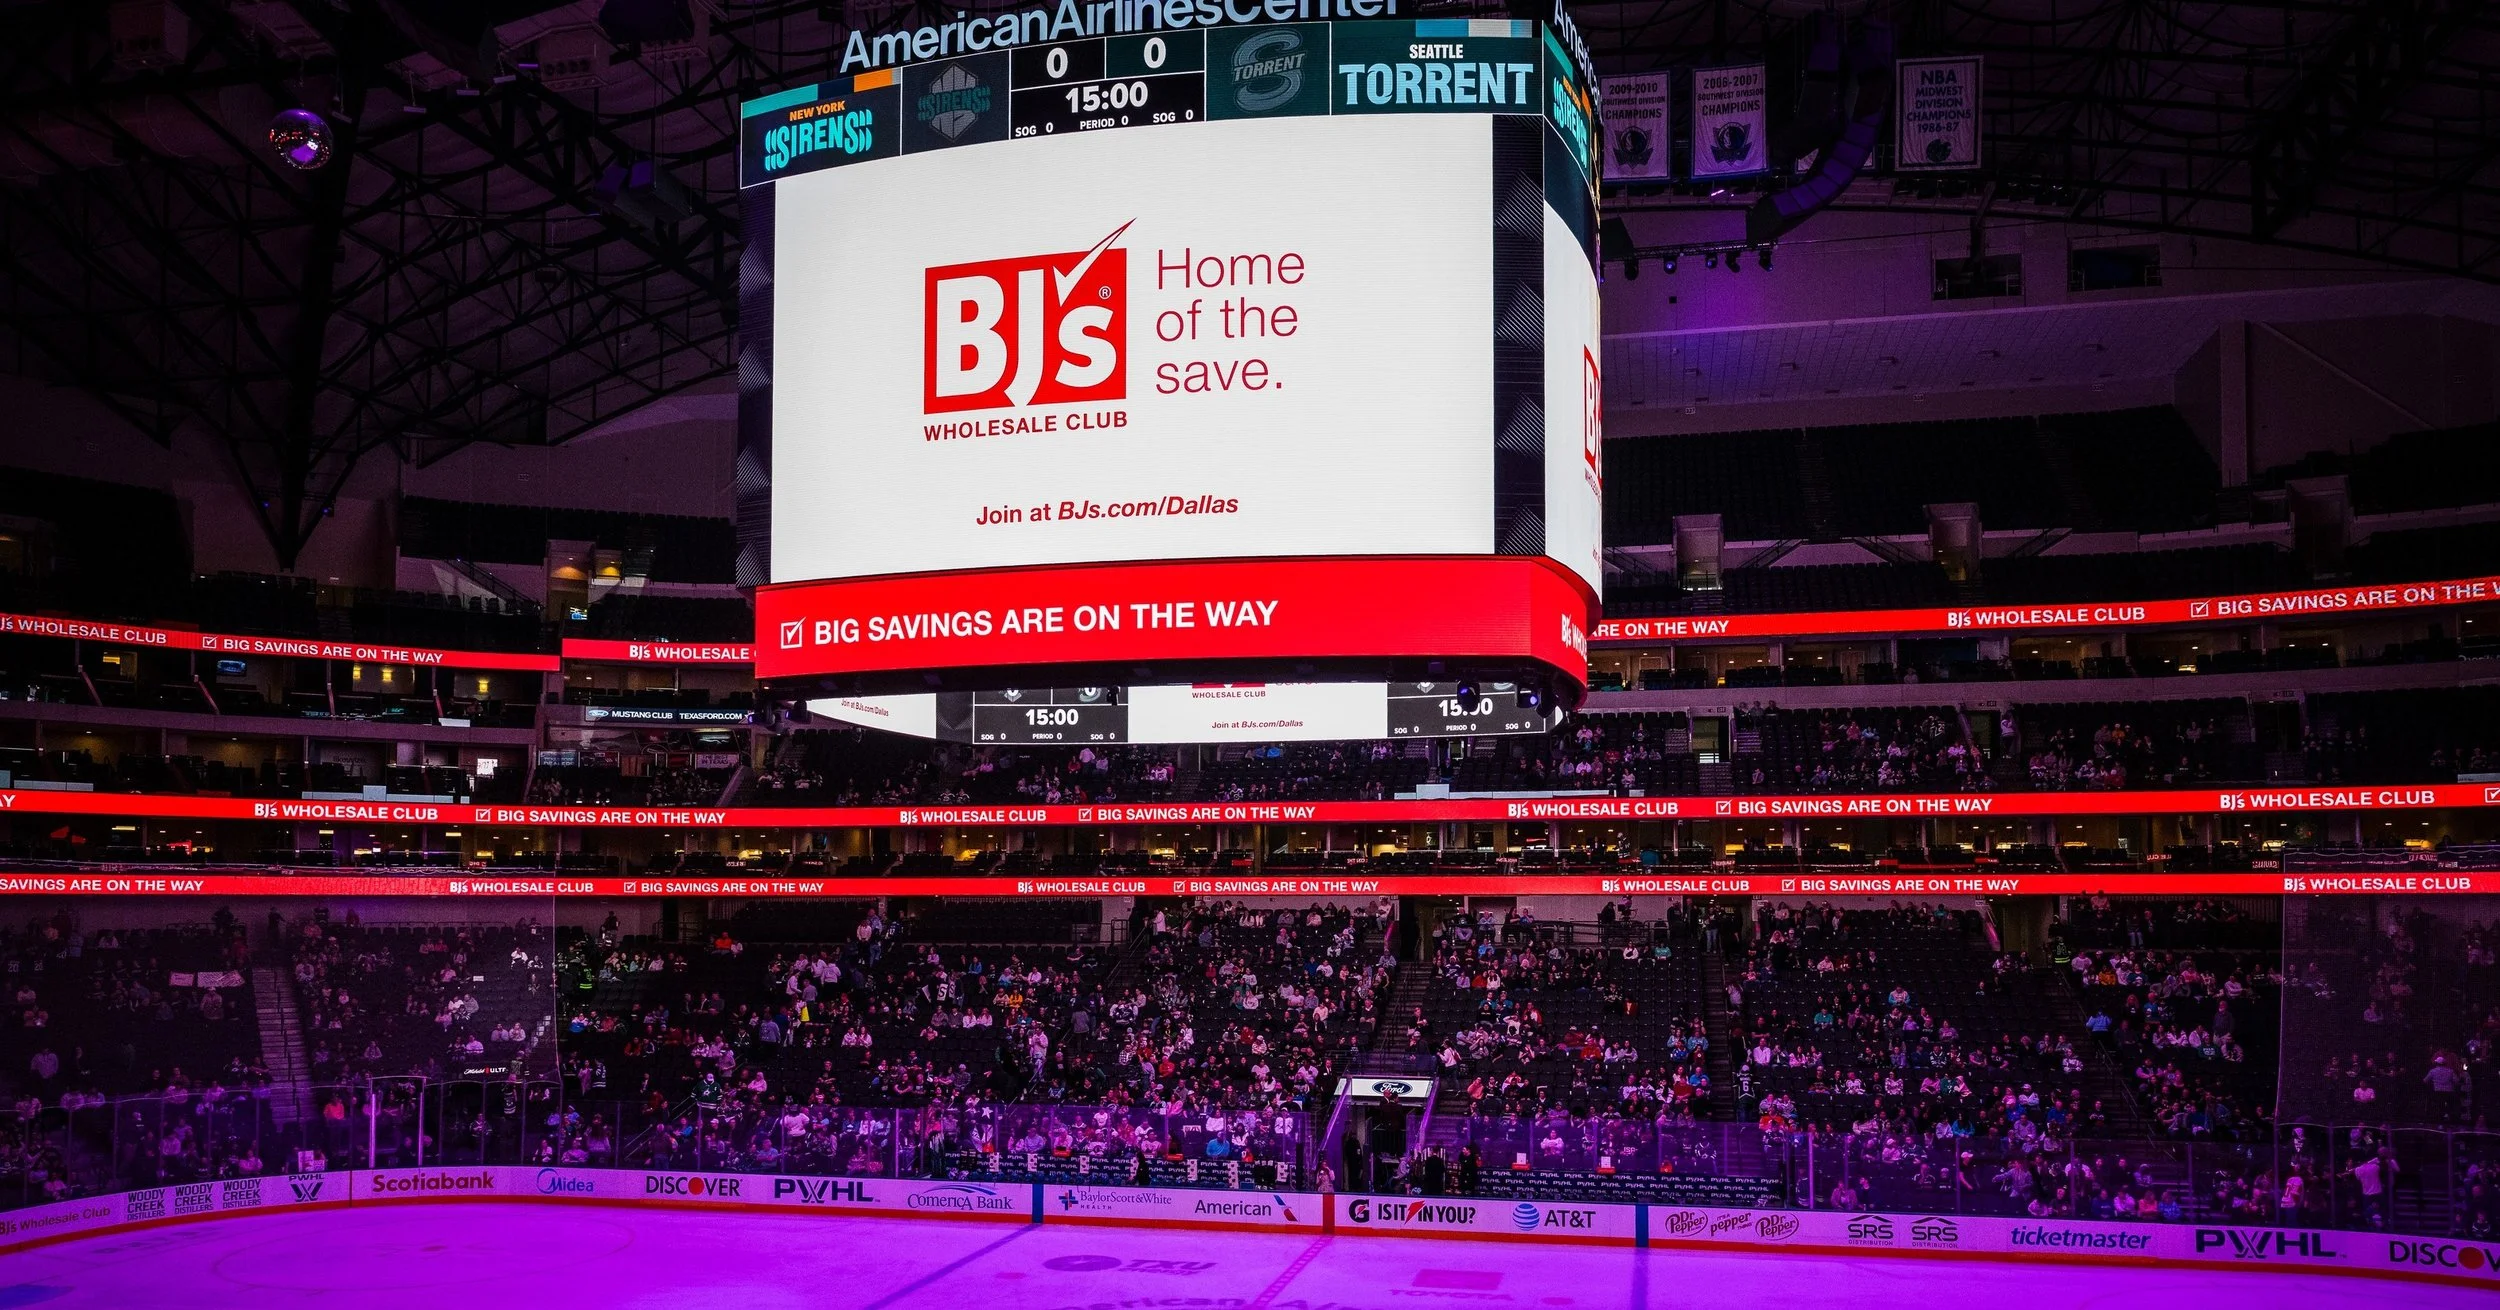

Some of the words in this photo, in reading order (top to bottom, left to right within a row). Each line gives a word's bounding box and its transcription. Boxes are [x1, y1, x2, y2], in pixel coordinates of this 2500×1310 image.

[1144, 37, 1166, 68] 0
[1409, 44, 1463, 59] SEATTLE
[1046, 47, 1068, 78] 0
[1233, 52, 1305, 82] TORRENT
[1339, 62, 1533, 105] TORRENT
[1702, 74, 1758, 89] 2006-2007
[1920, 69, 1957, 85] NBA
[1065, 81, 1149, 114] 15:00
[1608, 82, 1658, 96] 2009-2010
[1915, 84, 1963, 98] MIDWEST
[789, 106, 813, 122] NEW
[816, 100, 846, 117] YORK
[1702, 100, 1761, 116] CHAMPIONS
[1914, 97, 1963, 110] DIVISION
[1080, 117, 1115, 131] PERIOD
[1121, 114, 1129, 127] 0
[1152, 111, 1176, 124] SOG
[1185, 109, 1193, 121] 0
[1605, 107, 1662, 121] CHAMPIONS
[1906, 109, 1971, 122] CHAMPIONS
[1015, 125, 1037, 138] SOG
[1045, 121, 1054, 134] 0
[1917, 121, 1959, 134] 1986-87
[765, 108, 872, 171] SIRENS
[1158, 247, 1305, 290] Home
[1156, 299, 1202, 342] of
[1219, 296, 1298, 339] the
[1156, 356, 1282, 395] save.
[923, 414, 1057, 442] WHOLESALE
[1066, 410, 1128, 431] CLUB
[976, 505, 1022, 526] Join
[1029, 503, 1052, 523] at
[1057, 495, 1239, 521] BJs.com/Dallas
[2218, 599, 2252, 615] BIG
[2258, 593, 2348, 611] SAVINGS
[2353, 589, 2397, 606] ARE
[2403, 587, 2435, 603] ON
[2441, 582, 2487, 600] THE
[814, 618, 860, 645] BIG
[867, 610, 993, 642] SAVINGS
[1000, 606, 1064, 635] ARE
[1073, 604, 1120, 632] ON
[1129, 602, 1195, 629] THE
[1204, 600, 1279, 627] WAY
[1947, 610, 1972, 629] BJ's
[1975, 608, 2089, 625] WHOLESALE
[2094, 606, 2145, 622] CLUB
[17, 619, 120, 640] WHOLESALE
[124, 629, 167, 644] CLUB
[1625, 622, 1649, 637] ON
[1654, 621, 1688, 635] THE
[1692, 619, 1729, 634] WAY
[223, 638, 250, 651] BIG
[254, 640, 319, 656] SAVINGS
[322, 645, 352, 658] ARE
[355, 647, 382, 660] ON
[381, 649, 409, 661] THE
[412, 651, 443, 664] WAY
[629, 644, 651, 660] BJ's
[654, 646, 750, 660] WHOLESALE
[1192, 689, 1241, 699] WHOLESALE
[1244, 689, 1266, 698] CLUB
[611, 710, 651, 720] MUSTANG
[651, 711, 673, 720] CLUB
[679, 711, 742, 721] TEXASFORD.COM
[1026, 708, 1079, 726] 15:00
[1211, 719, 1229, 729] Join
[1231, 720, 1240, 729] at
[1241, 718, 1304, 729] BJs.com/Dallas
[1394, 727, 1408, 735] SOG
[1413, 725, 1420, 734] 0
[1446, 724, 1467, 732] PERIOD
[1470, 723, 1477, 732] 0
[1525, 721, 1531, 729] 0
[981, 733, 994, 741] SOG
[1000, 732, 1006, 741] 0
[1032, 733, 1054, 741] PERIOD
[1057, 732, 1062, 741] 0
[1090, 733, 1104, 741] SOG
[1110, 732, 1115, 740] 0
[2220, 792, 2246, 811] BJ's
[2249, 791, 2373, 808] WHOLESALE
[2378, 790, 2435, 806] CLUB
[254, 801, 278, 819] BJ's
[282, 804, 389, 819] WHOLESALE
[392, 807, 439, 821] CLUB
[497, 809, 525, 822] BIG
[529, 810, 597, 824] SAVINGS
[599, 810, 632, 824] ARE
[635, 811, 658, 824] ON
[661, 812, 690, 824] THE
[693, 812, 726, 824] WAY
[0, 878, 66, 891] SAVINGS
[69, 879, 102, 891] ARE
[106, 879, 131, 891] ON
[134, 879, 166, 891] THE
[170, 880, 204, 891] WAY
[223, 1179, 261, 1192] WOODY
[288, 1173, 325, 1182] PWHL
[372, 1171, 495, 1193] Scotiabank
[548, 1172, 594, 1193] Midea
[175, 1184, 213, 1198] WOODY
[645, 1175, 742, 1198] DISCOVER
[774, 1178, 876, 1204] PWHL
[127, 1189, 166, 1203] WOODY
[174, 1195, 212, 1208] CREEK
[223, 1190, 260, 1203] CREEK
[976, 1195, 1014, 1210] Bank
[127, 1200, 165, 1214] CREEK
[175, 1204, 213, 1216] DISTILLERS
[223, 1200, 261, 1210] DISTILLERS
[1194, 1198, 1272, 1217] American
[1349, 1198, 1370, 1223] G
[20, 1211, 79, 1231] Wholesale
[82, 1206, 111, 1220] Club
[127, 1210, 166, 1222] DISTILLERS
[1436, 1206, 1476, 1224] YOU?
[1544, 1209, 1596, 1229] AT&T
[1680, 1211, 1695, 1223] Dr
[1771, 1215, 1785, 1226] Dr
[1670, 1214, 1705, 1234] Pepper
[1710, 1212, 1751, 1236] pepper
[1760, 1217, 1796, 1238] Pepper
[1848, 1223, 1894, 1240] SRS
[1911, 1225, 1959, 1242] SRS
[2011, 1225, 2152, 1250] ticketmaster
[2194, 1228, 2338, 1259] PWHL
